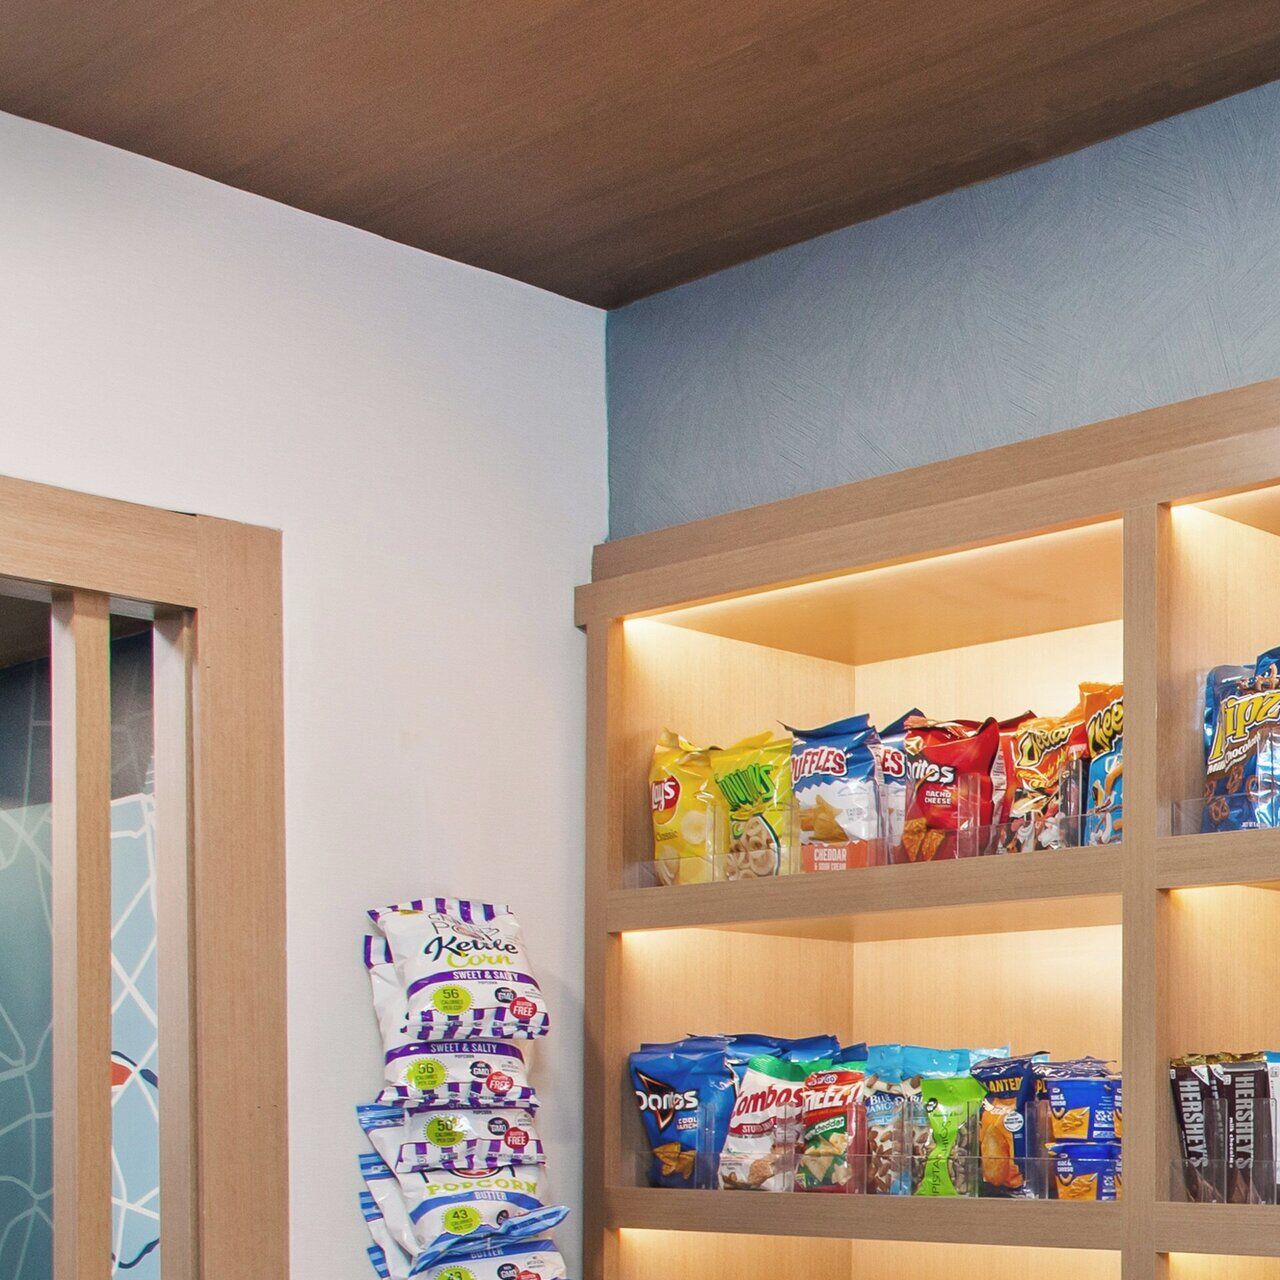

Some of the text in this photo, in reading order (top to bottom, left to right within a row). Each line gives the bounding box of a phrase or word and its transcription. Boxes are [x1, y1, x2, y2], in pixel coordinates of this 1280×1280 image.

[814, 849, 846, 862] CHEDDAR
[443, 989, 459, 999] 56
[513, 1006, 533, 1016] FREE
[417, 1062, 435, 1073] 56
[1179, 1080, 1208, 1168] HERSHEY'S
[1235, 1075, 1255, 1169] HERSHEY'S
[426, 1180, 537, 1196] POPCORN
[474, 1190, 508, 1201] BUTTER
[451, 1210, 468, 1220] 43
